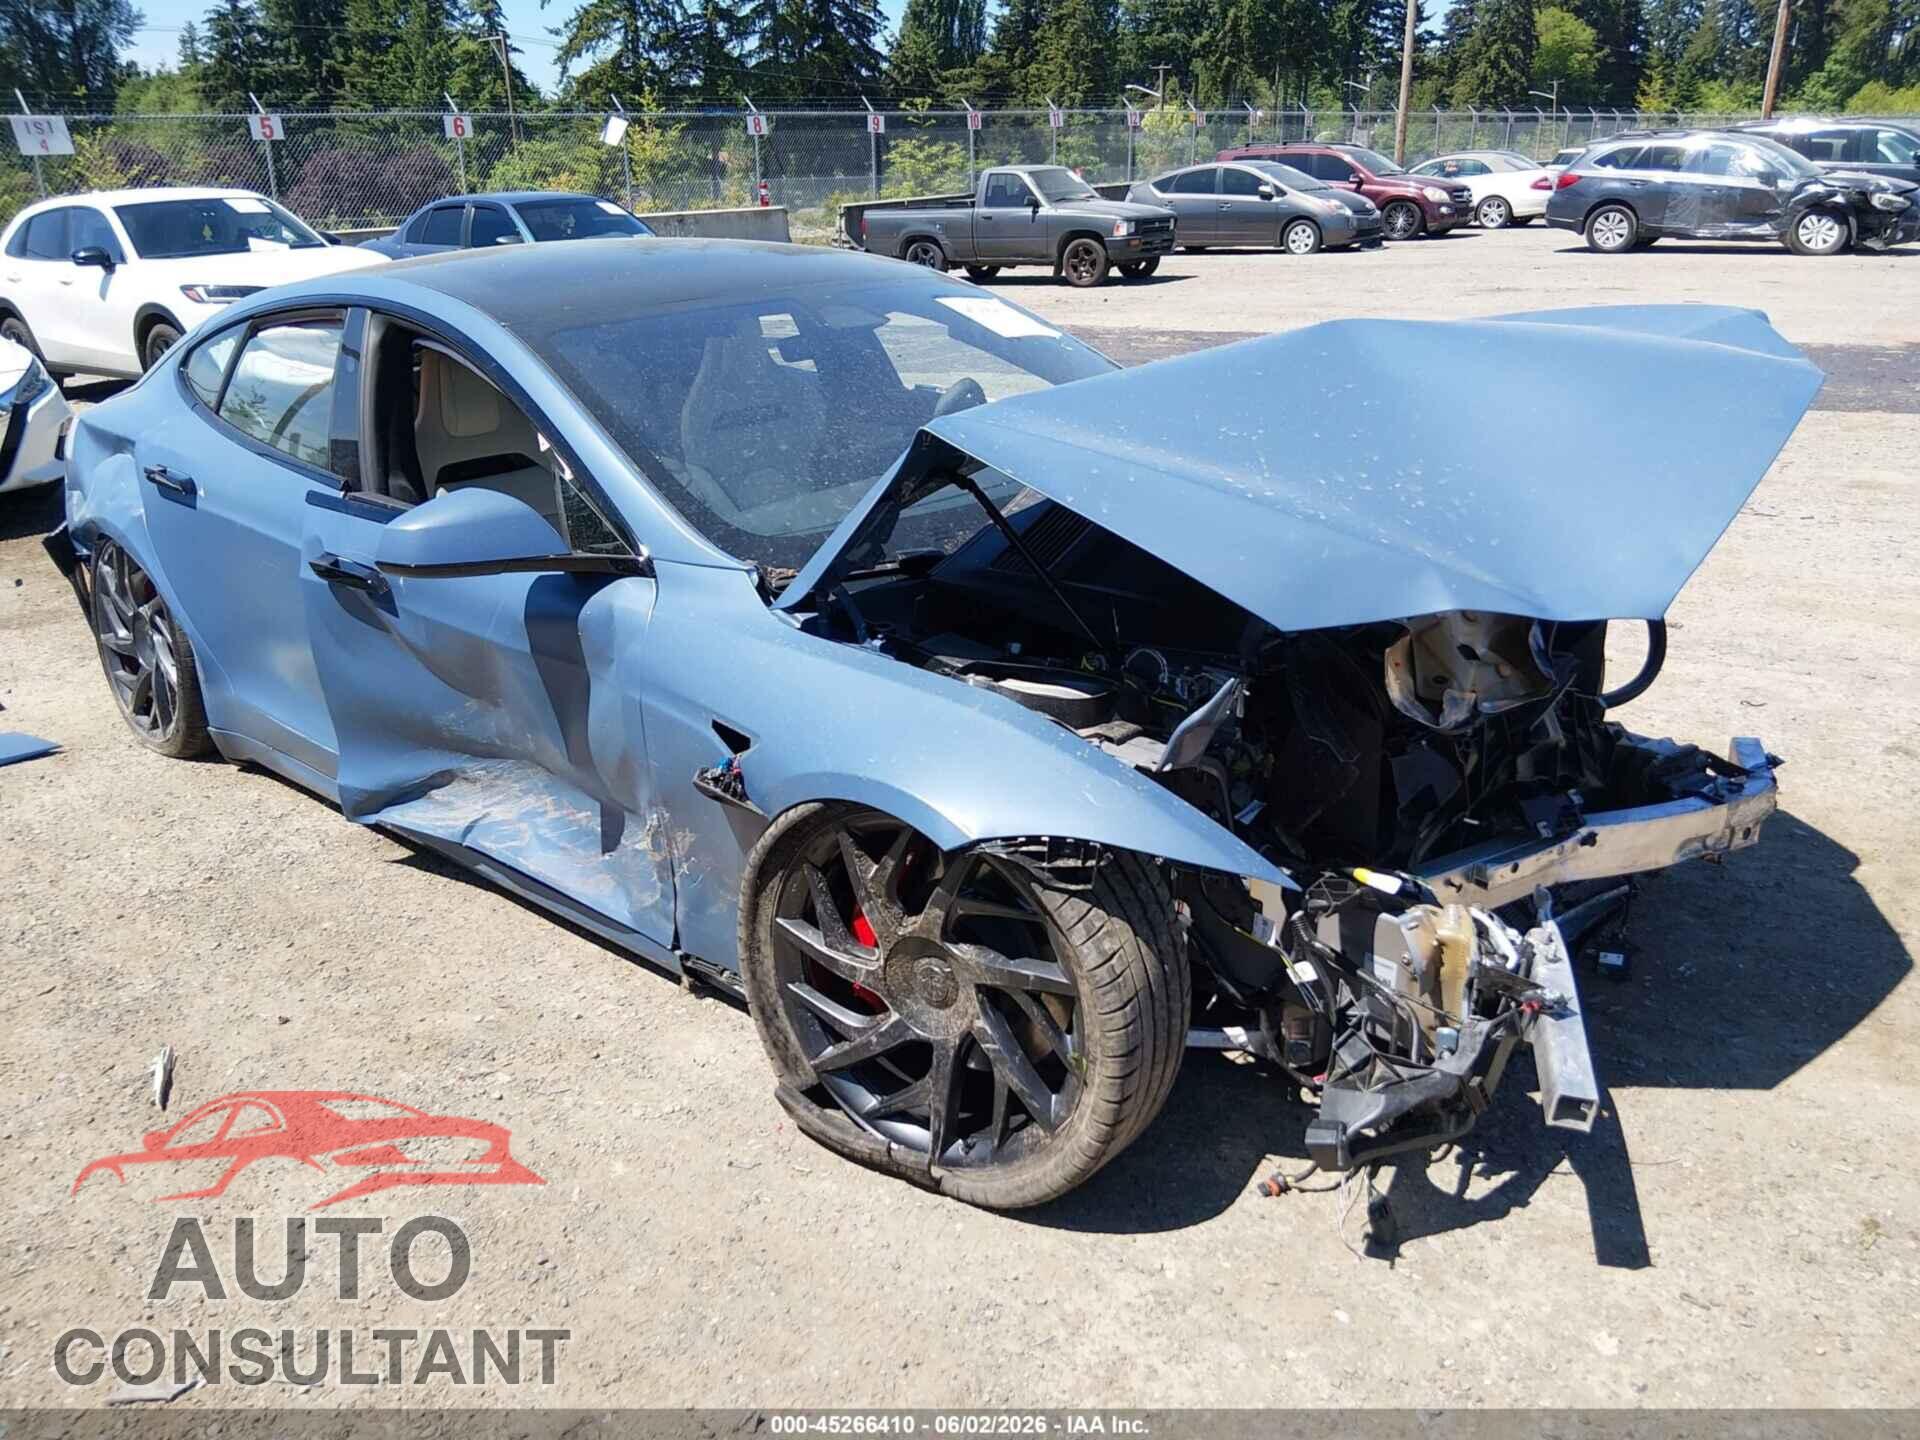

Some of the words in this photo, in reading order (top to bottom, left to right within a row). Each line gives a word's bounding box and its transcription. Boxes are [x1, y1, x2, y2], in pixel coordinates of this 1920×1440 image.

[259, 116, 274, 139] 5
[452, 117, 465, 137] 6
[753, 116, 762, 134] 8
[871, 116, 880, 132] 9
[969, 112, 979, 128] 10
[1052, 112, 1060, 127] 11
